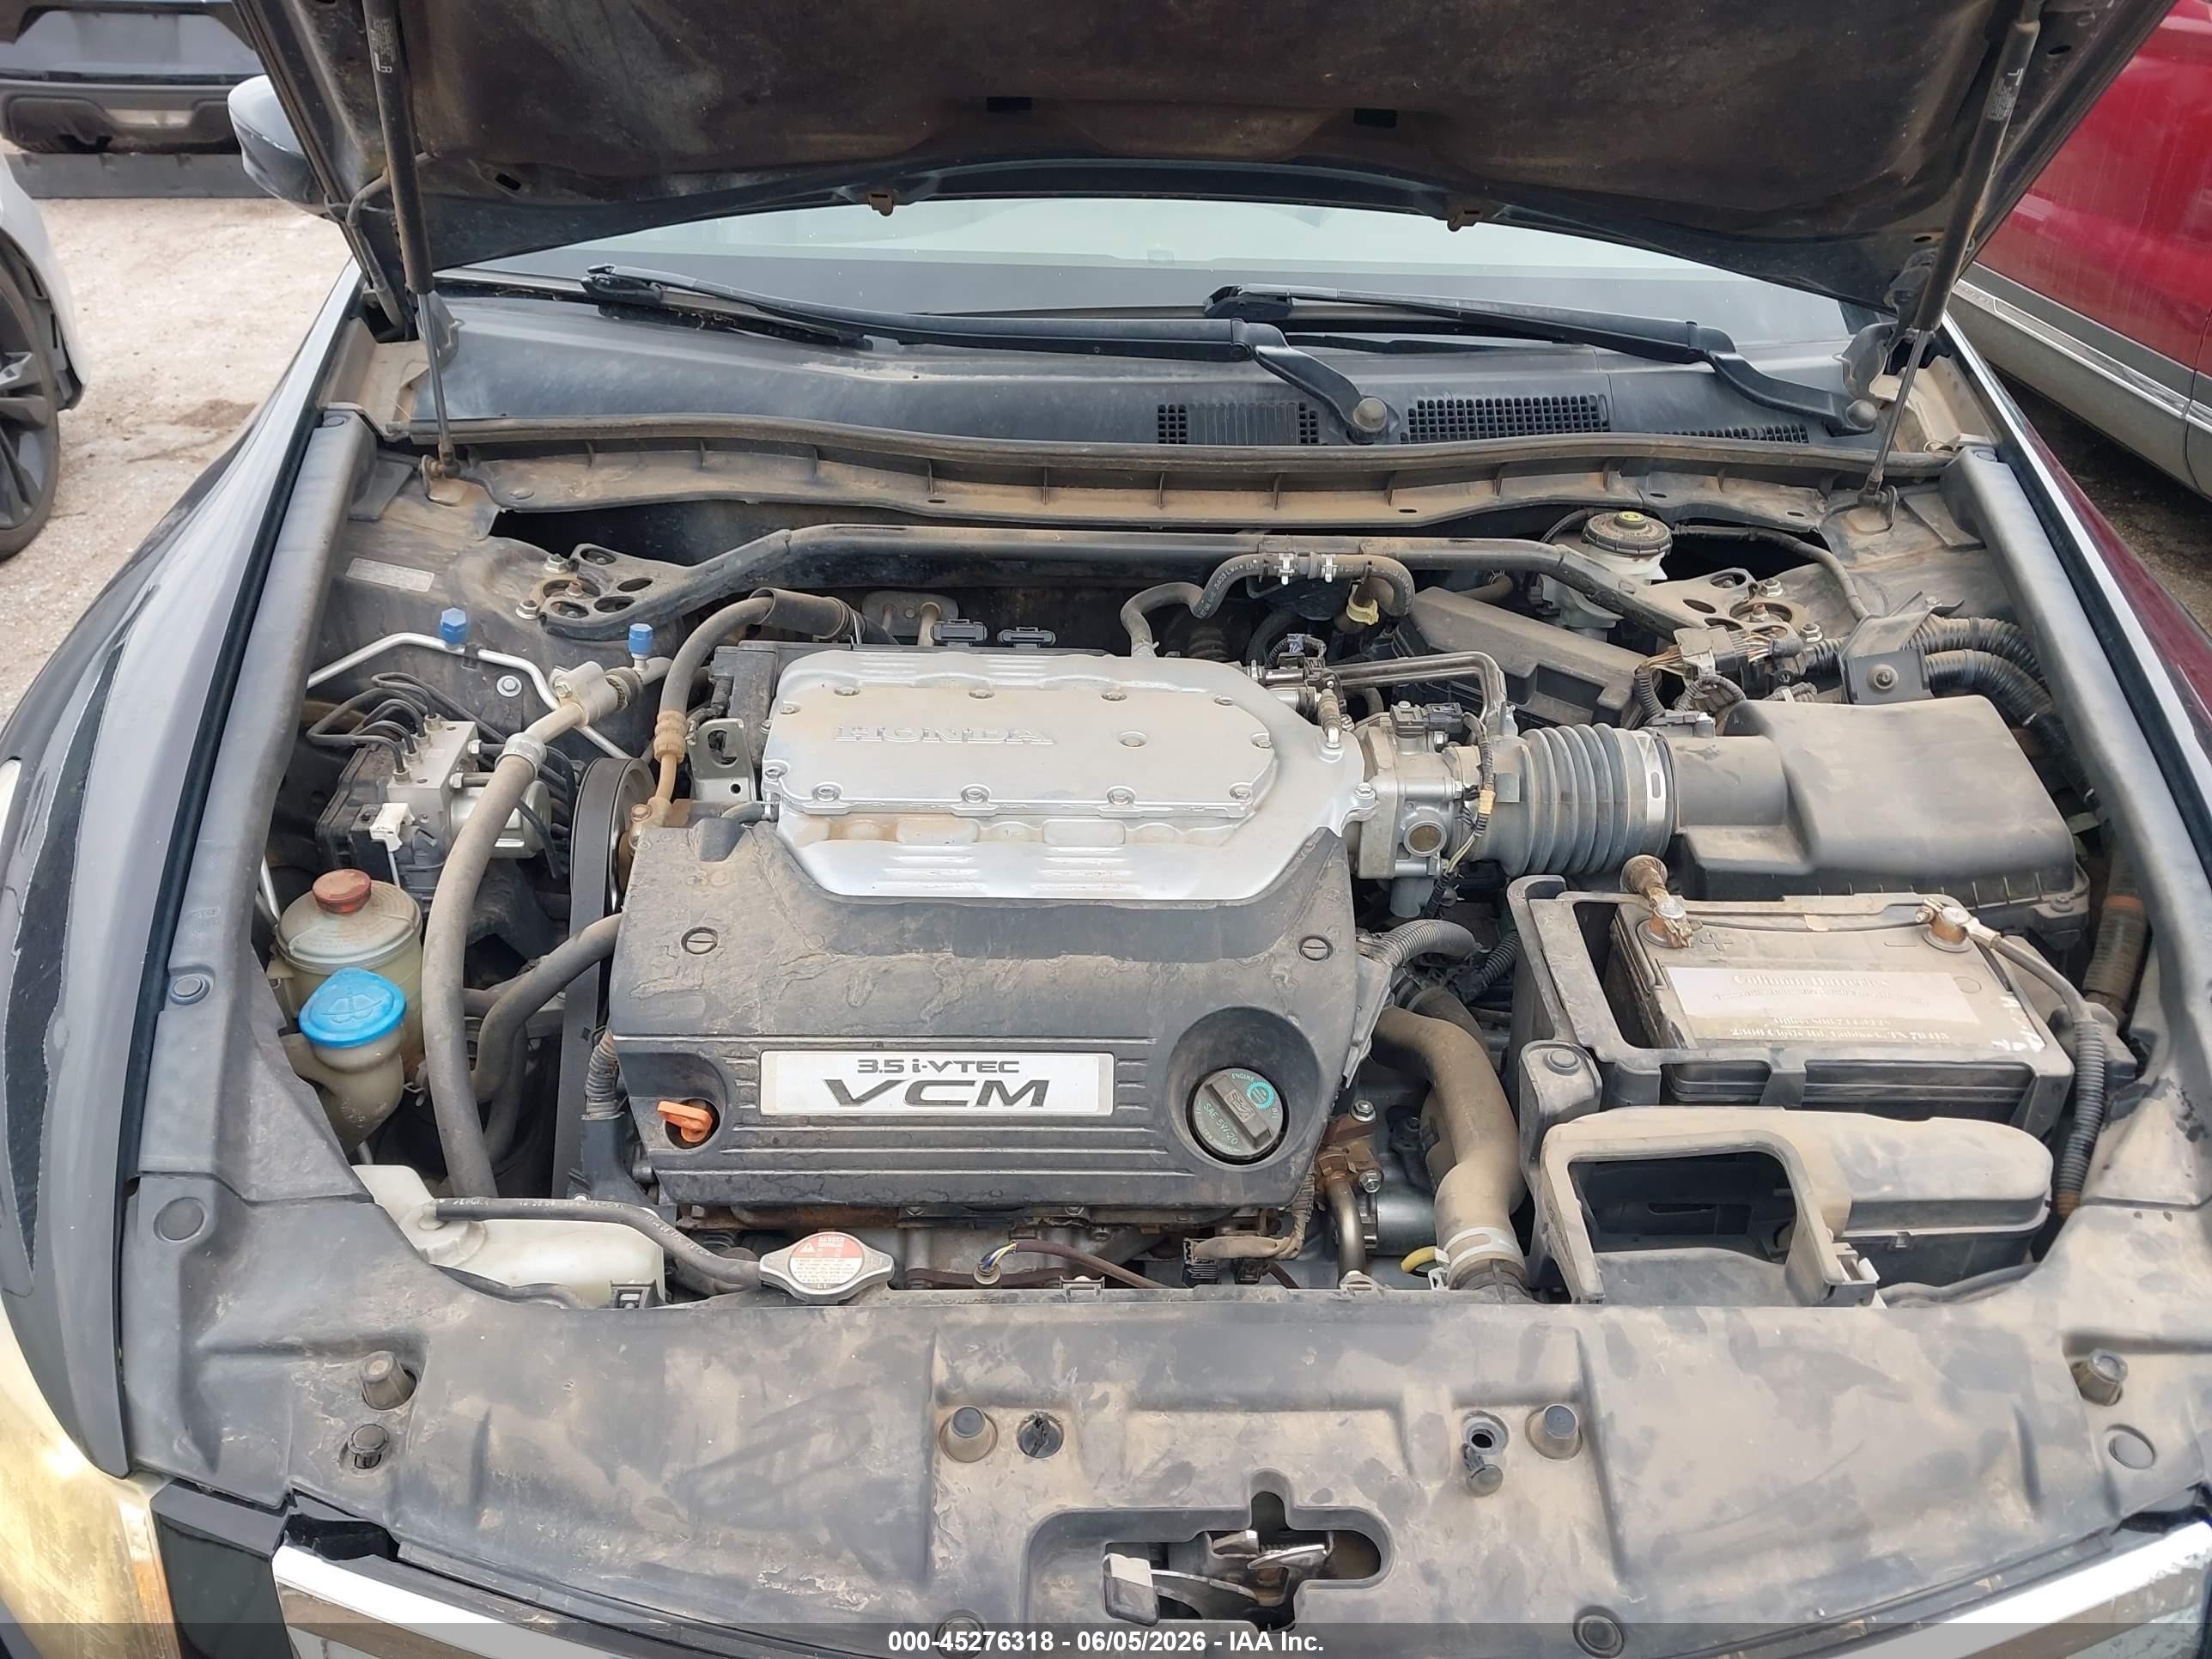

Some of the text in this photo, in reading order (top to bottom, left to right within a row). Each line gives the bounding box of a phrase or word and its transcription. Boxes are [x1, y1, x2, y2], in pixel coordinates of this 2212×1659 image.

[835, 725, 1056, 745] HONDA
[857, 1058, 1019, 1073] 3.5 i-VTEC
[823, 1079, 1051, 1107] VCM
[1203, 1103, 1219, 1120] SAE
